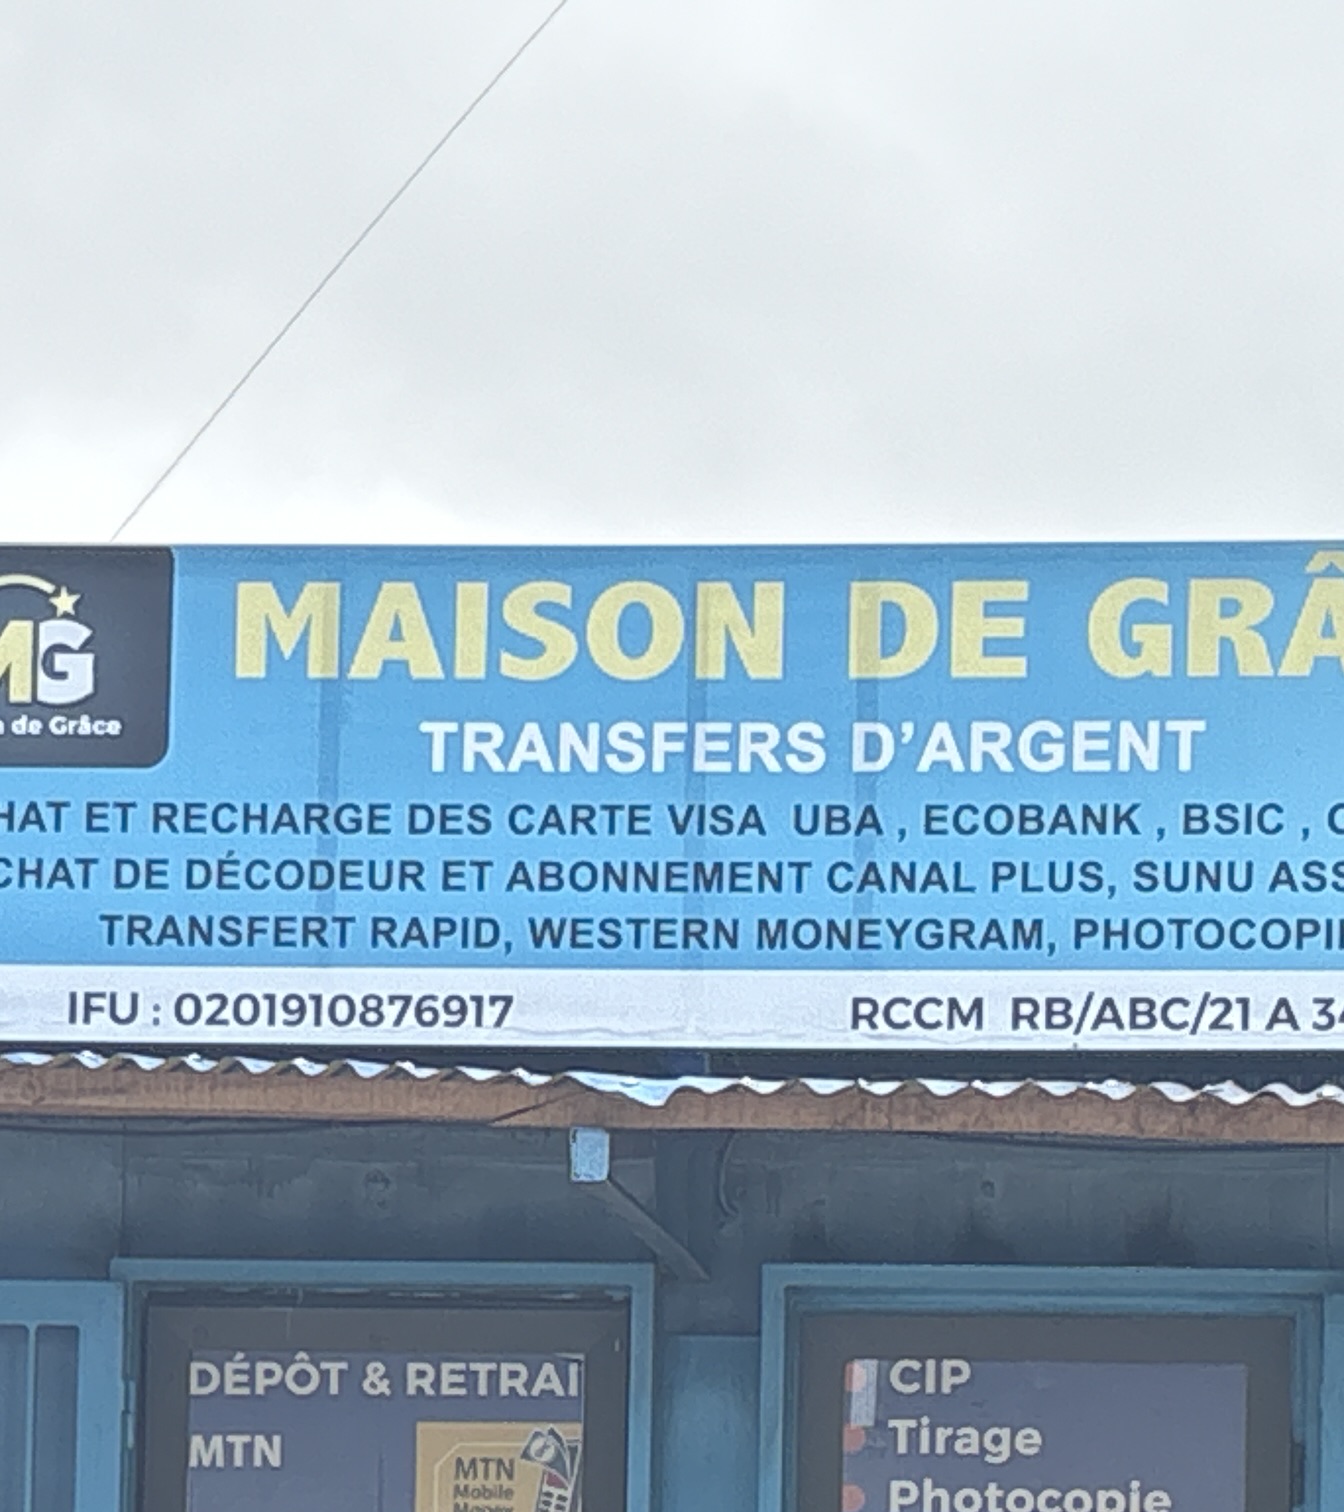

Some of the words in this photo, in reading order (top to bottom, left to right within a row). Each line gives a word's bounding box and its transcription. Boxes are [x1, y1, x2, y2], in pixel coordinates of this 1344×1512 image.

[235, 579, 783, 681] MAISON
[848, 579, 1029, 680] DE
[10, 714, 43, 737] de
[47, 710, 123, 738] Grâce
[419, 720, 826, 773] TRANSFERS
[854, 718, 1207, 773] D’ARGENT
[86, 802, 137, 834] ET
[151, 801, 392, 836] RECHARGE
[407, 803, 493, 836] DES
[507, 803, 651, 837] CARTE
[667, 803, 768, 837] VISA
[792, 803, 884, 837] UBA
[923, 802, 1141, 836] ECOBANK
[1181, 801, 1286, 836] BSIC
[113, 858, 170, 891] DE
[186, 850, 425, 893] DÉCODEUR
[442, 860, 493, 892] ET
[506, 860, 813, 894] ABONNEMENT
[827, 860, 978, 894] CANAL
[990, 860, 1117, 900] PLUS,
[1133, 860, 1255, 894] SUNU
[99, 914, 356, 949] TRANSFERT
[370, 916, 514, 956] RAPID,
[528, 917, 740, 951] WESTERN
[756, 917, 1057, 957] MONEYGRAM,
[68, 991, 139, 1025] IFU
[173, 992, 514, 1028] 0201910876917
[850, 997, 985, 1032] RCCM
[1010, 993, 1251, 1036] RB/ABC/21
[1264, 999, 1302, 1032] A
[189, 1351, 348, 1397] DÉPÔT
[362, 1364, 392, 1397] &
[888, 1357, 973, 1396] CIP
[189, 1433, 283, 1468] MTN
[887, 1415, 1044, 1464] Tirage
[454, 1456, 515, 1482] MTN
[453, 1483, 514, 1501] Mobile
